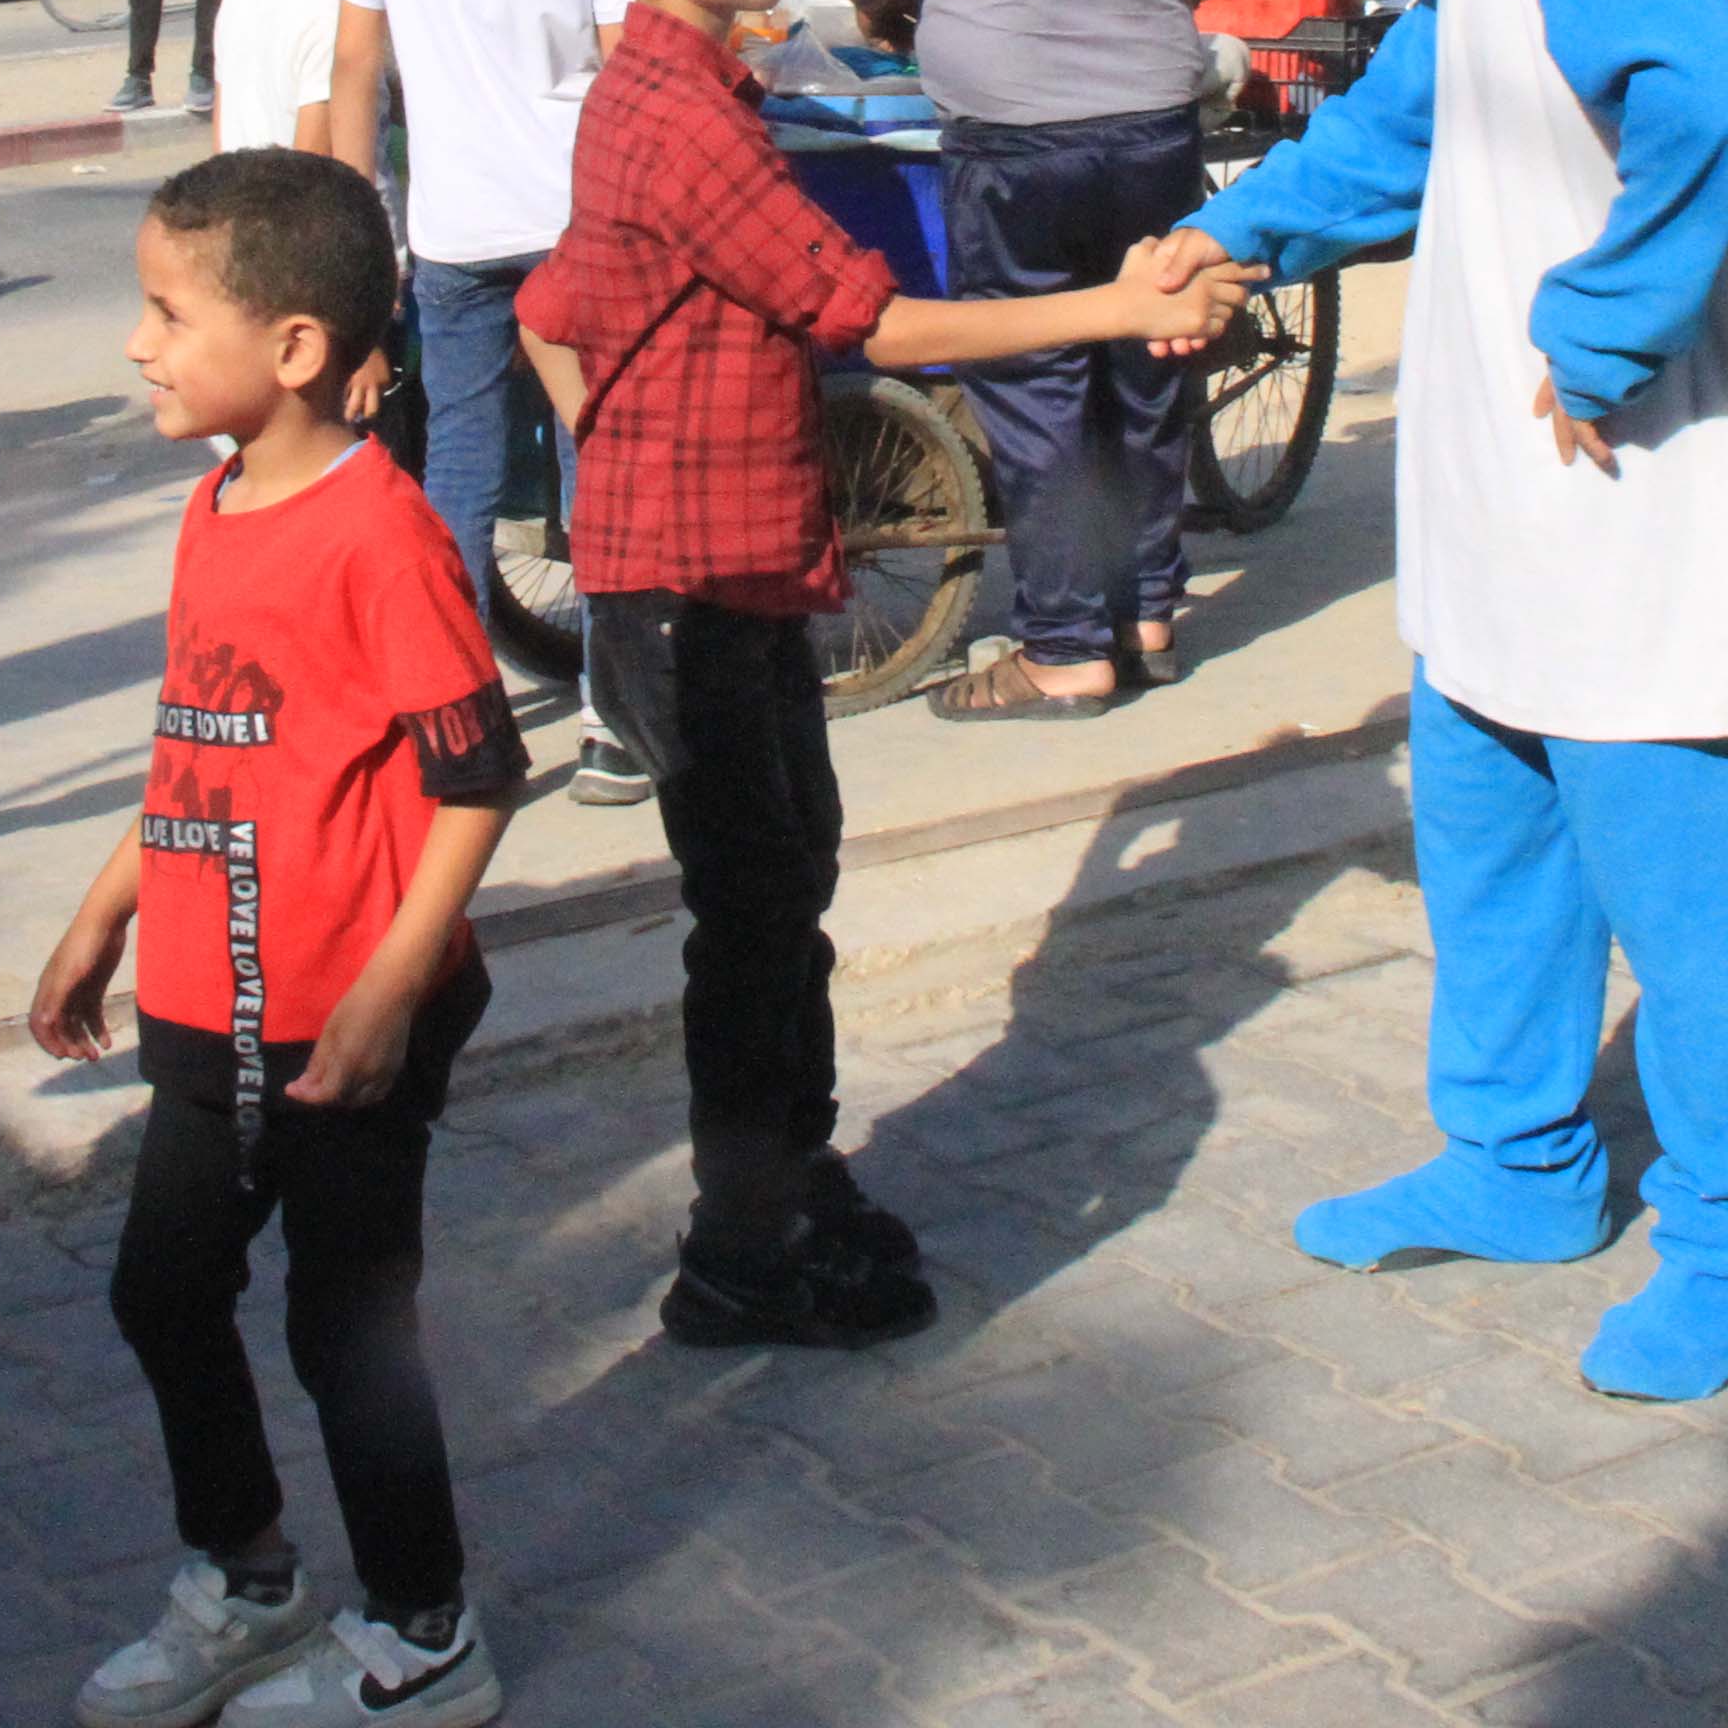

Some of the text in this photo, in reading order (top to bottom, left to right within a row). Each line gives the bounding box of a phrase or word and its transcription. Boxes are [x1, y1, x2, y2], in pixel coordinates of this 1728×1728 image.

[228, 864, 259, 938] LOVE
[231, 943, 264, 1013] LOVE
[234, 1018, 265, 1087] LOVE
